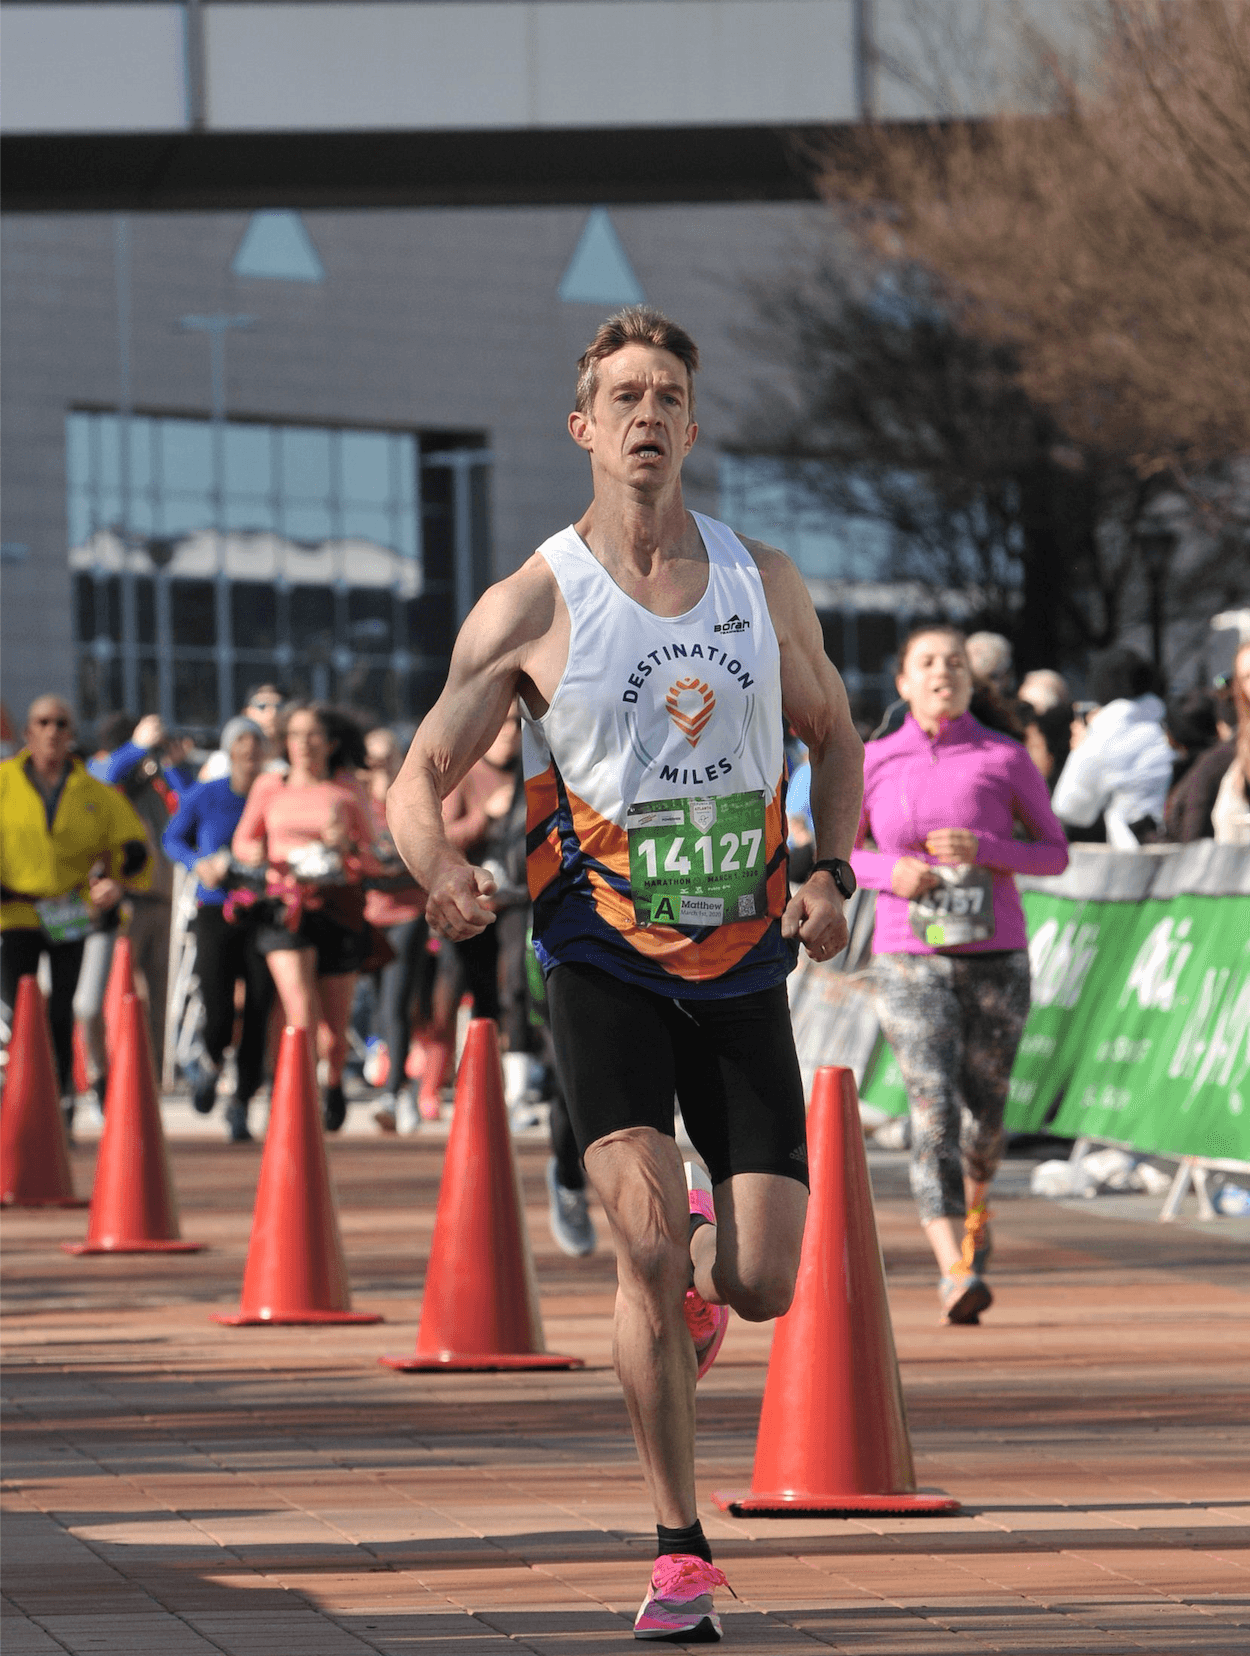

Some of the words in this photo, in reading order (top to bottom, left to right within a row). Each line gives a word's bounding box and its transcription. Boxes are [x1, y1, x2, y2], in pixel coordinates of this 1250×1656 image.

[622, 643, 754, 704] DESTINATION
[659, 757, 732, 785] MILES
[638, 828, 763, 877] 14127
[644, 878, 691, 887] MARATHON
[707, 874, 733, 883] MARCH
[654, 897, 675, 921] A
[681, 900, 722, 910] Matthew
